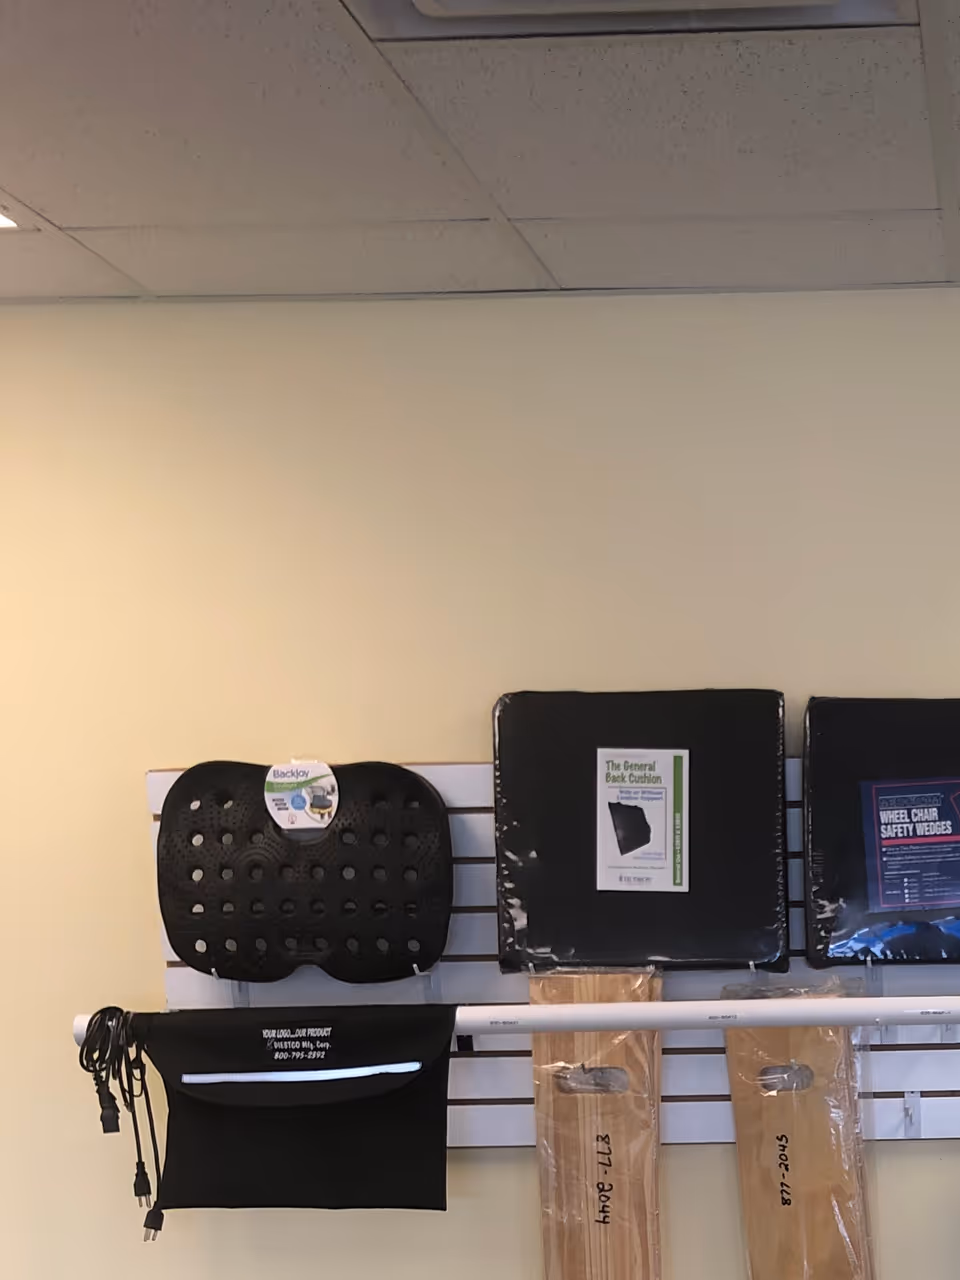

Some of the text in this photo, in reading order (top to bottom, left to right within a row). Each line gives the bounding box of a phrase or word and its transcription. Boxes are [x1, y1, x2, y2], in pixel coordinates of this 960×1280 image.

[605, 760, 656, 772] The General
[605, 772, 662, 785] Back Cushion
[880, 808, 939, 824] WHEEL CHAIR
[880, 820, 952, 838] SAFETY WEDGES
[262, 1029, 276, 1039] YOUR
[307, 1027, 333, 1037] PRODUCT
[776, 1134, 792, 1206] 877-2045
